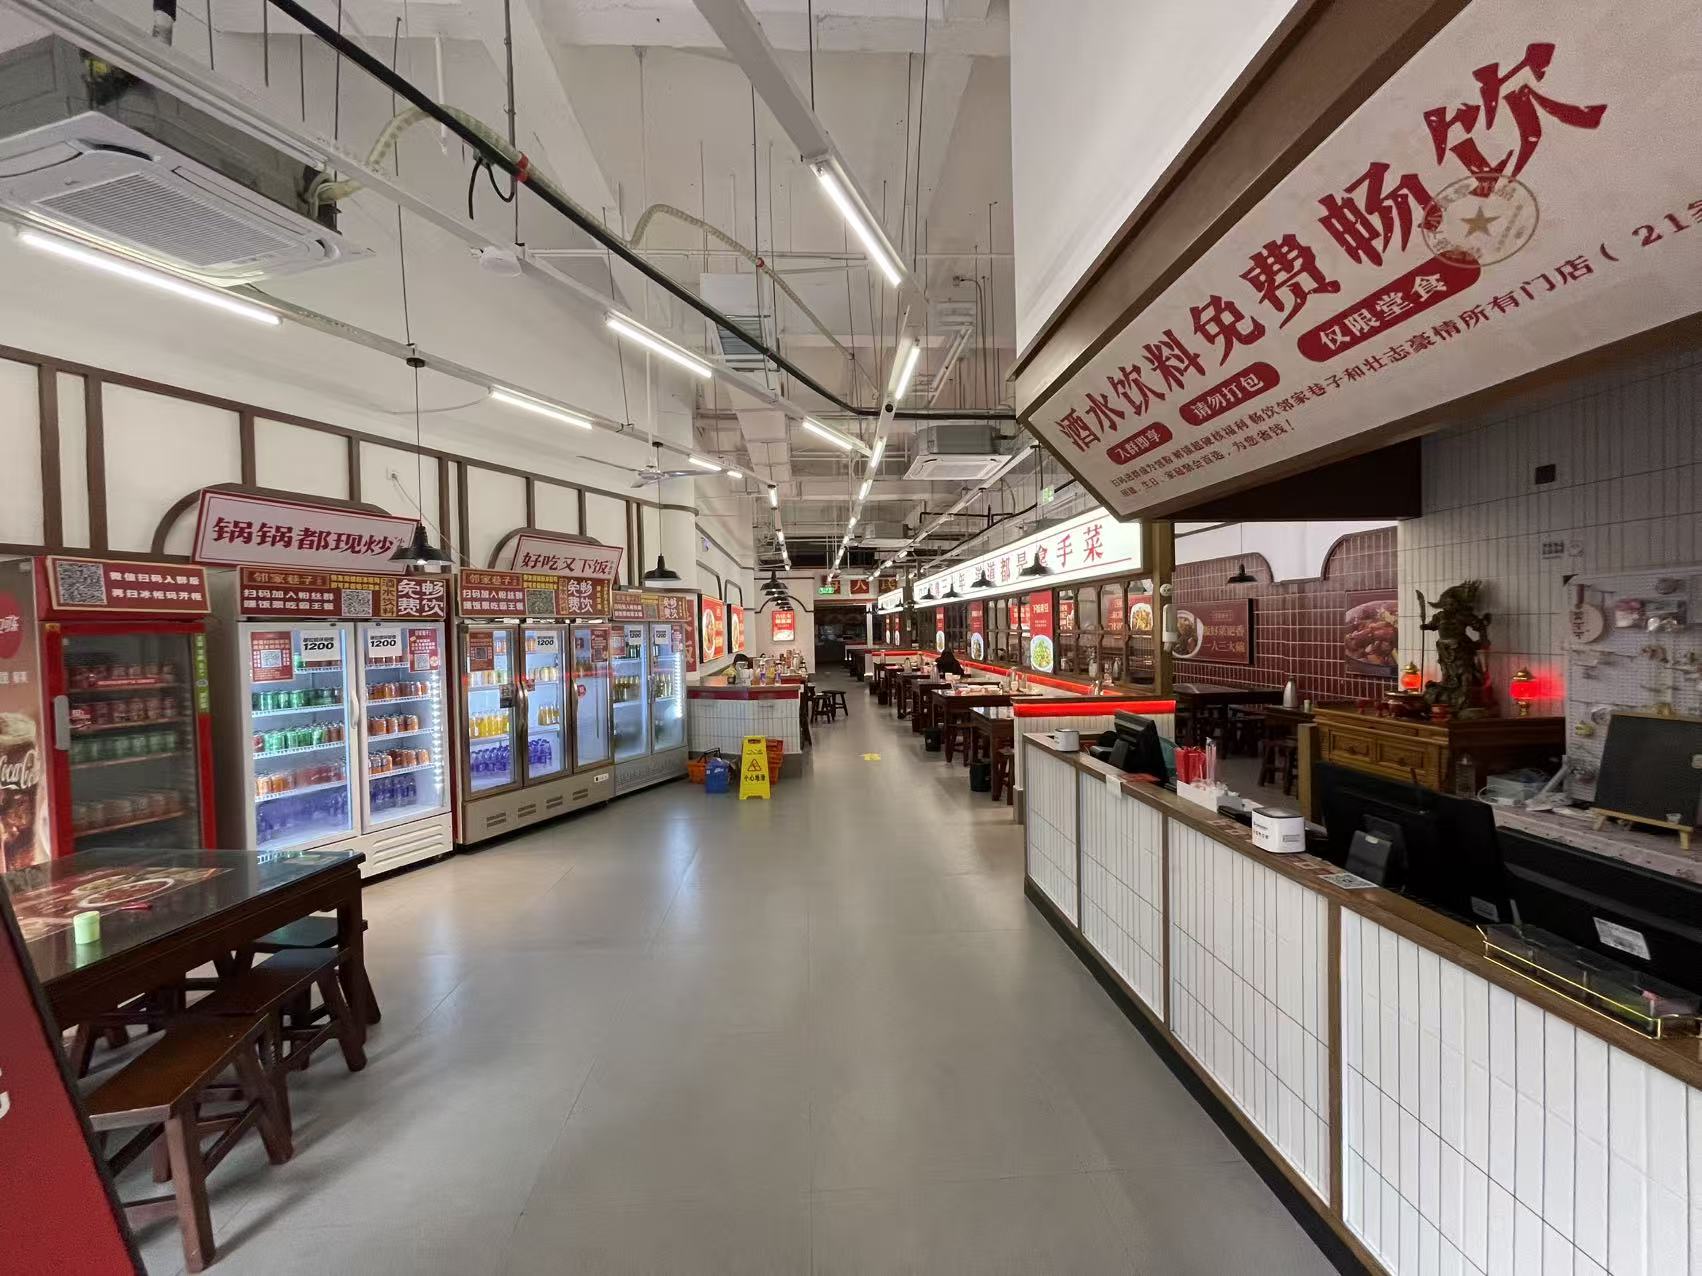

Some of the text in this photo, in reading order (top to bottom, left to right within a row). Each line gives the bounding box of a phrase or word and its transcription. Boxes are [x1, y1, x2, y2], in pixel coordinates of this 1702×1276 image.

[1055, 42, 1608, 452] 酒水饮料免费畅饮
[1319, 272, 1448, 351] 仅限堂食
[1192, 373, 1265, 420] 请勿打包
[1115, 428, 1161, 461] 入群即享
[212, 516, 394, 557] 锅锅都现炒
[520, 552, 608, 575] 好吃又下饭
[303, 642, 335, 651] 1200
[370, 639, 397, 648] 1200
